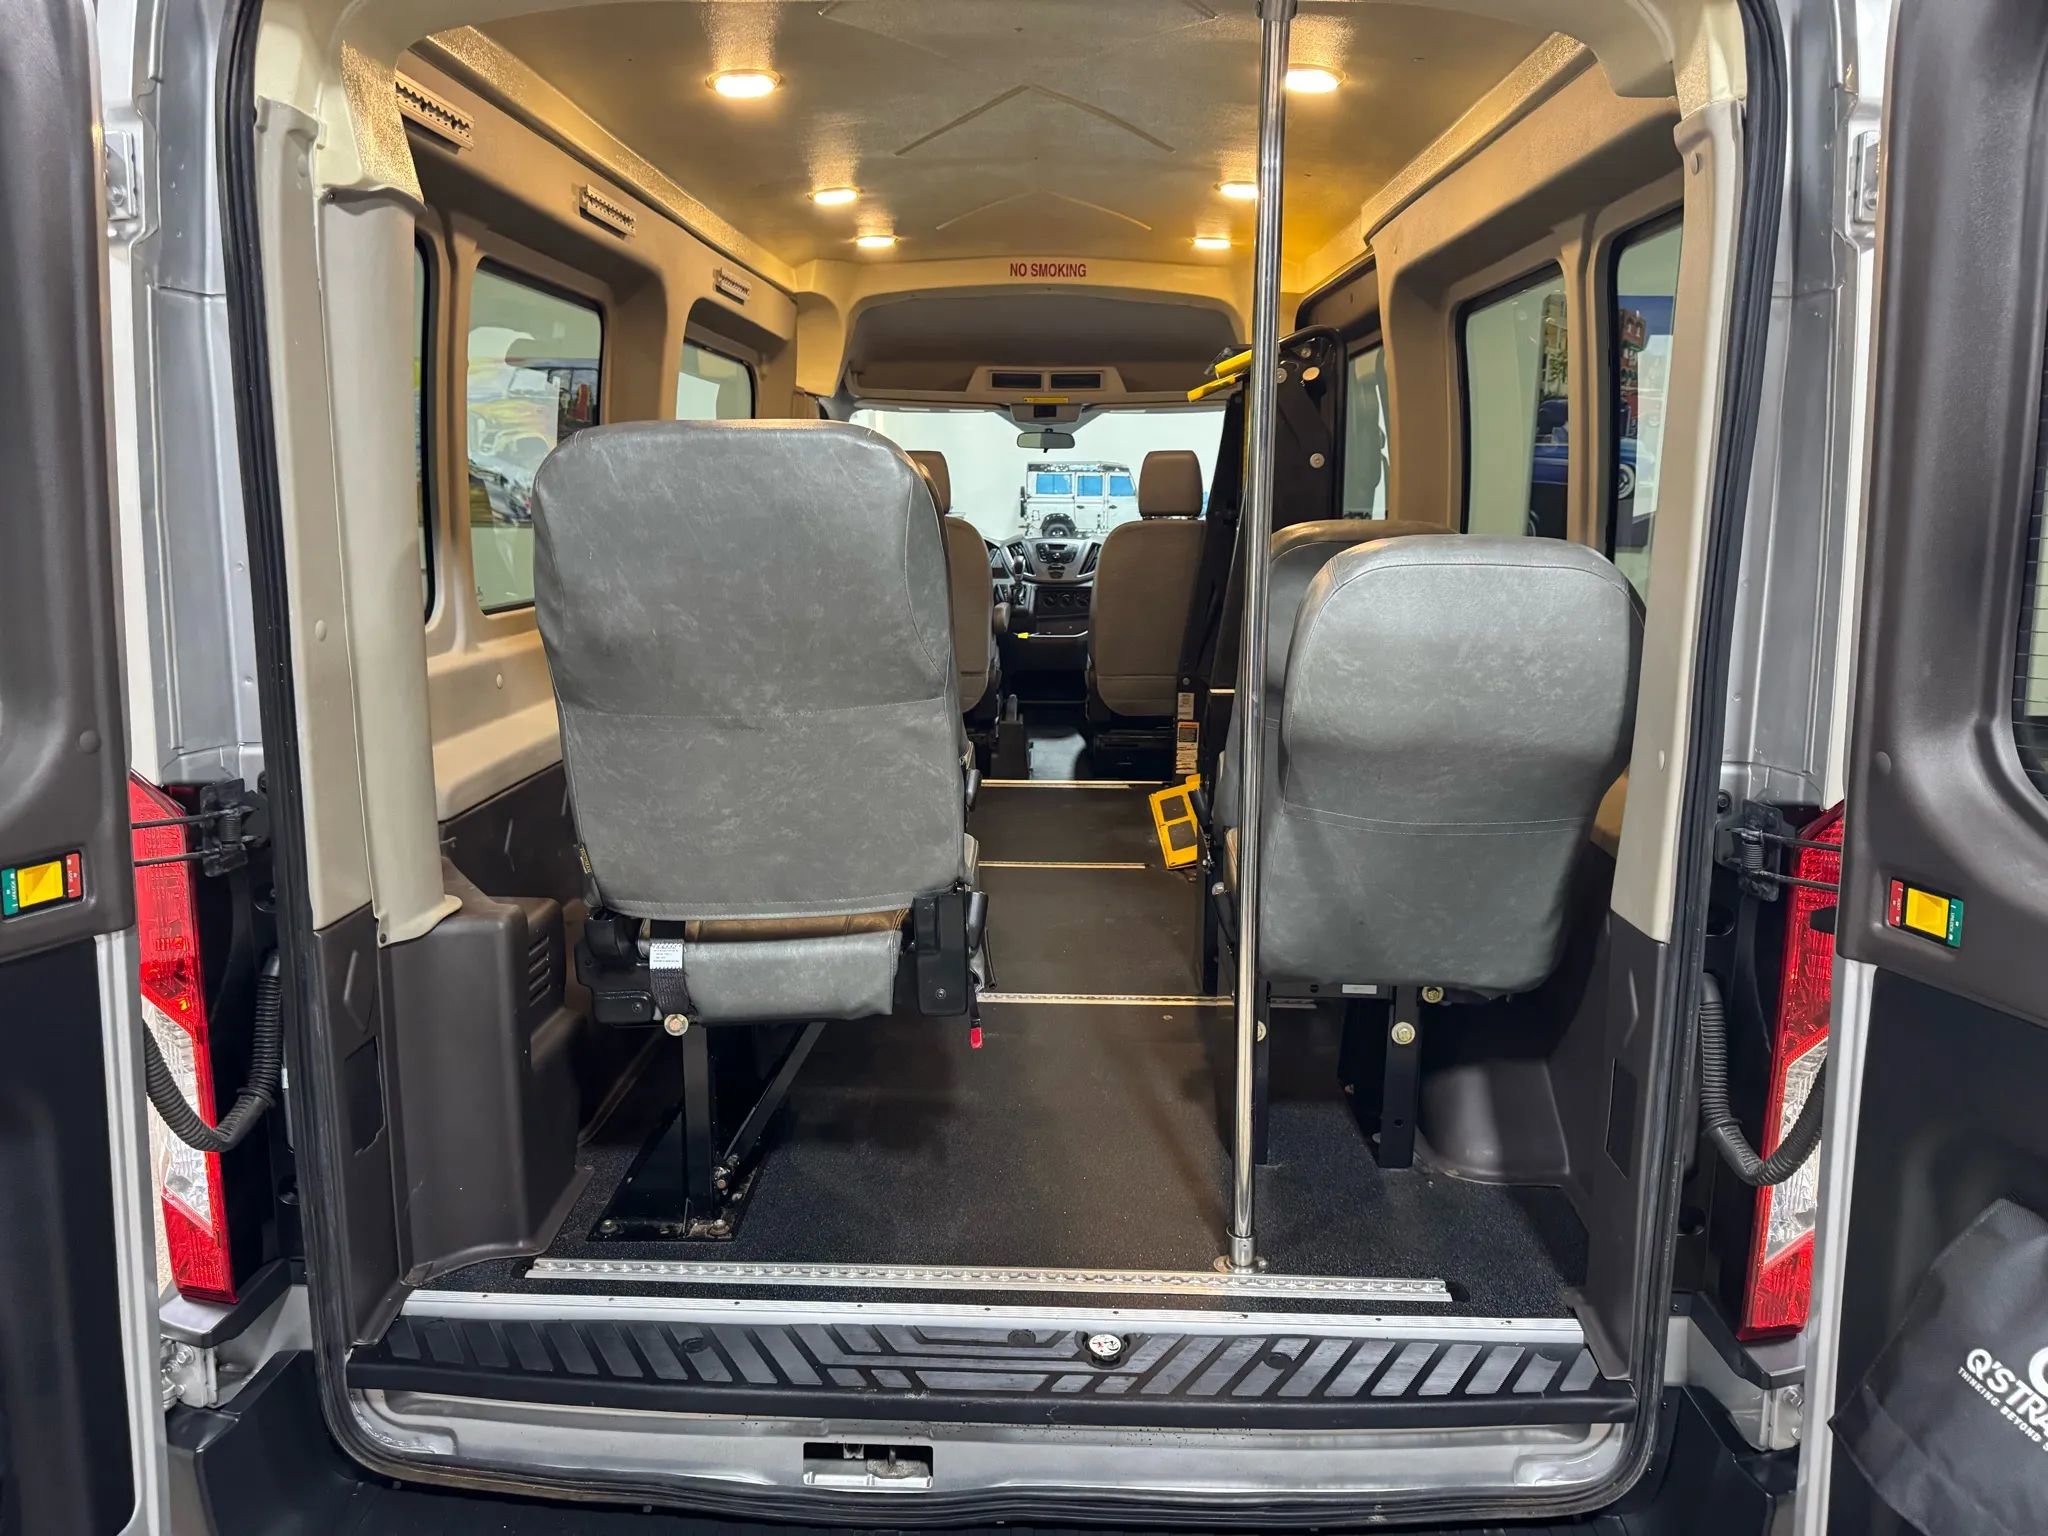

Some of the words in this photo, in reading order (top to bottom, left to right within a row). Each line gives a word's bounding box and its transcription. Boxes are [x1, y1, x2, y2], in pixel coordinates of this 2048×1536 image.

[1009, 262, 1028, 277] NO
[1030, 262, 1087, 278] SMOKING
[1958, 1366, 2001, 1407] THINKING
[2000, 1405, 2042, 1442] BEYOND
